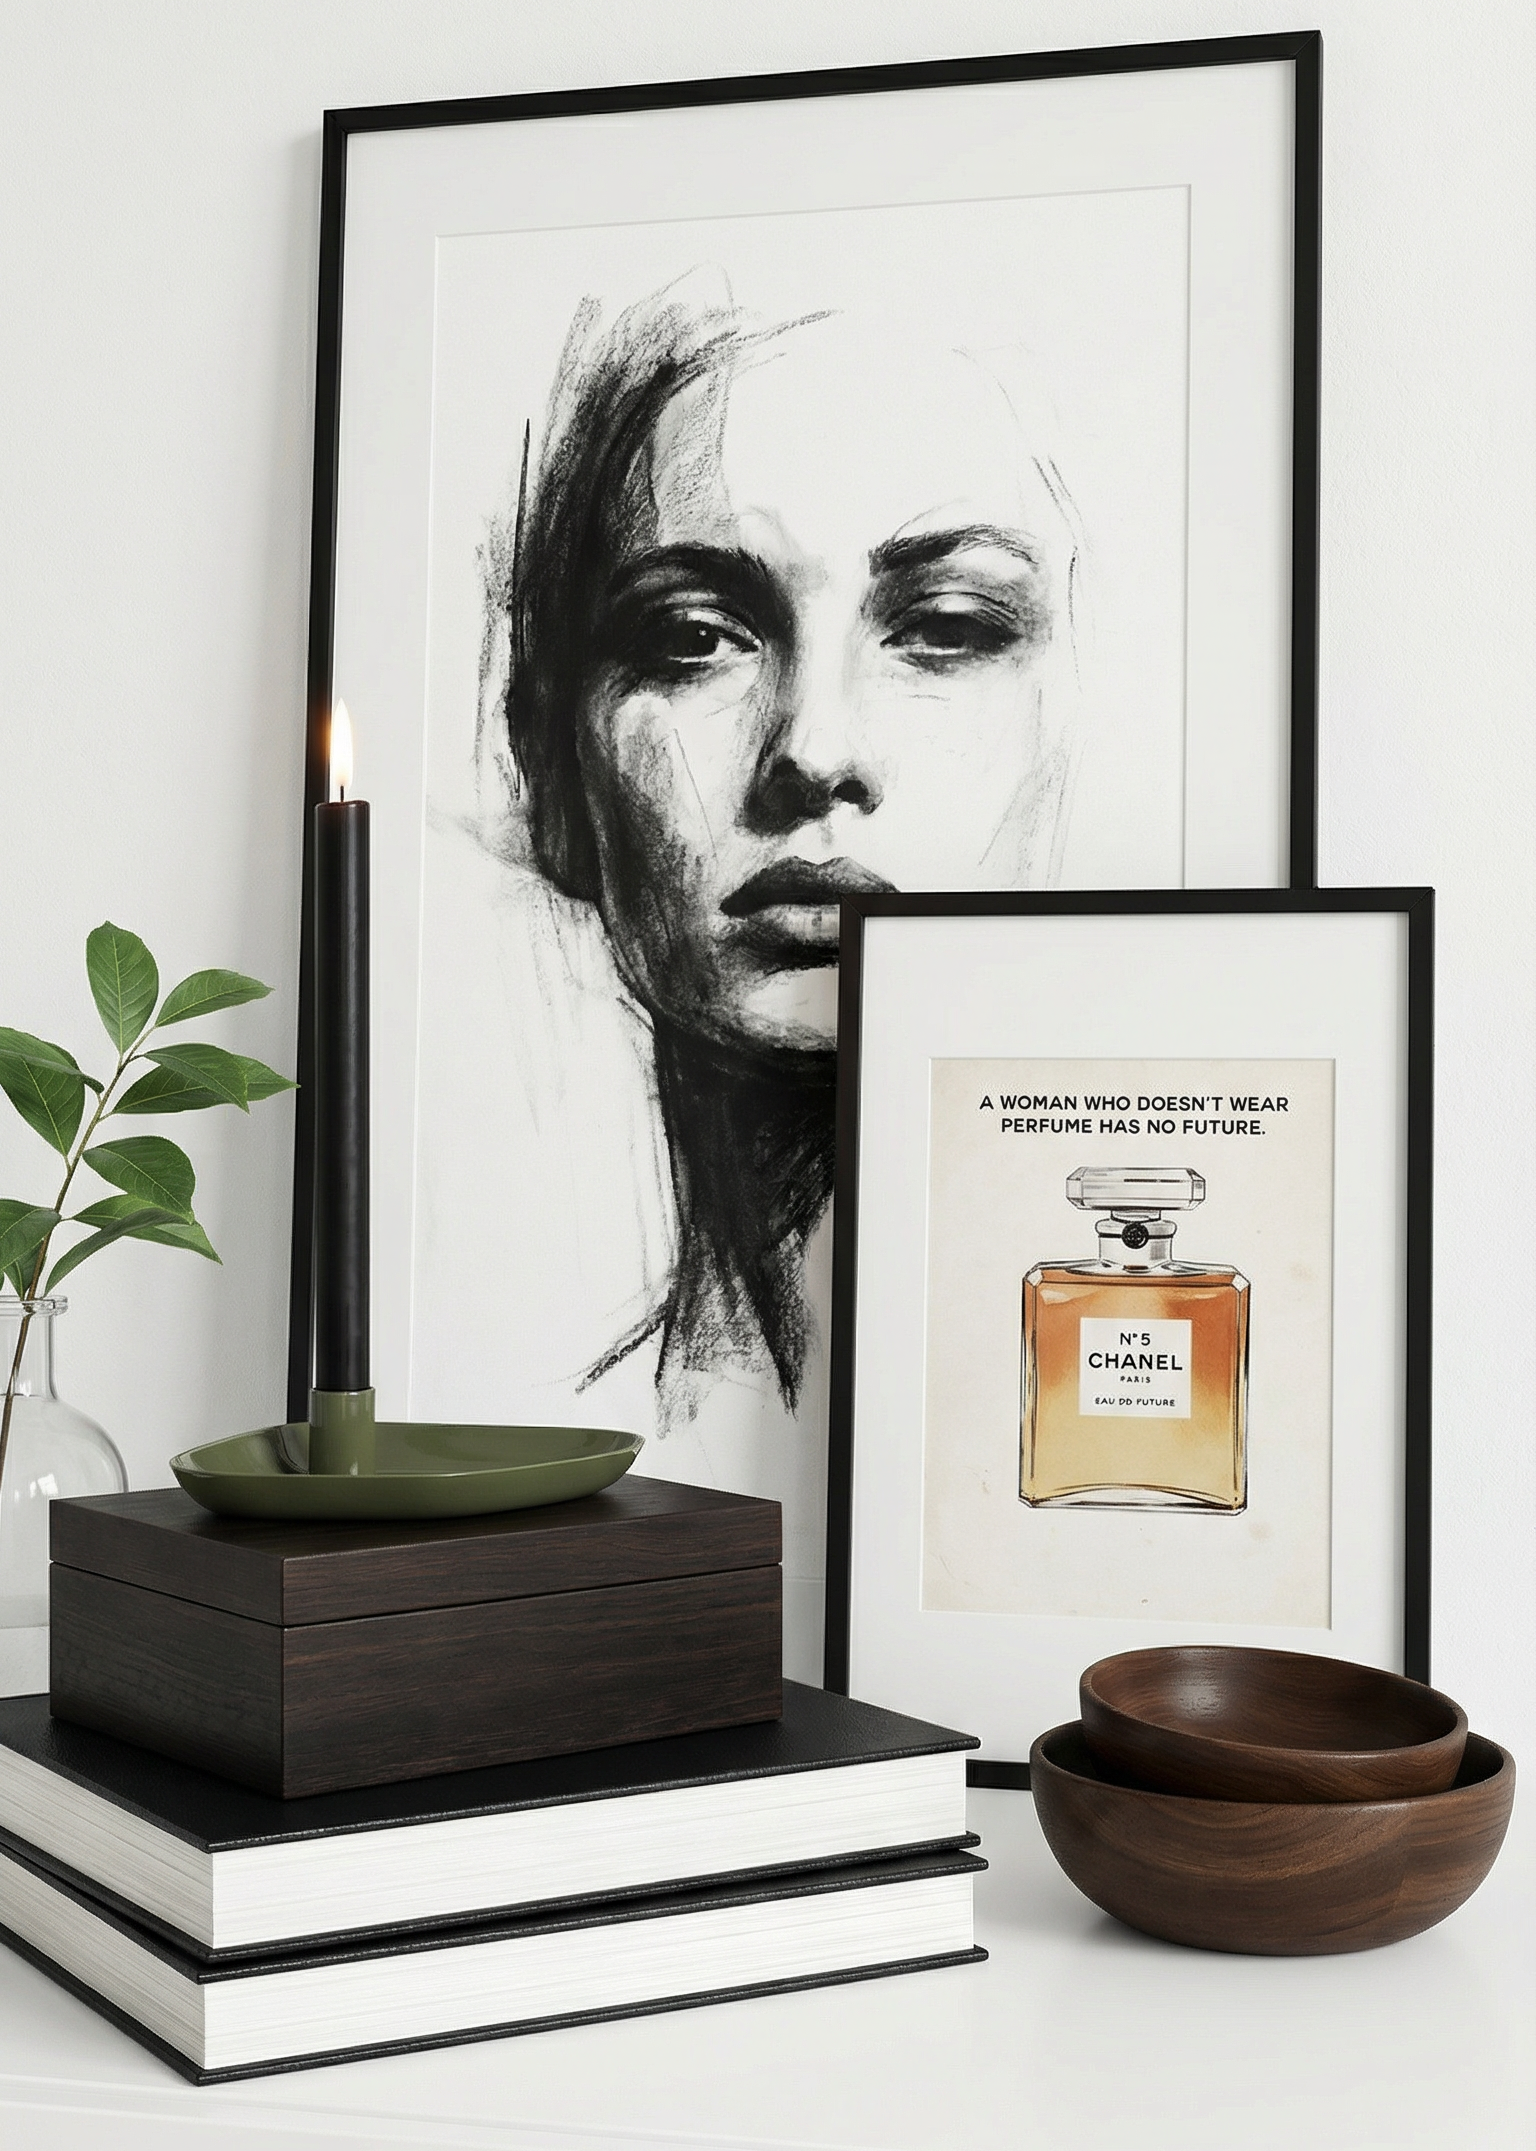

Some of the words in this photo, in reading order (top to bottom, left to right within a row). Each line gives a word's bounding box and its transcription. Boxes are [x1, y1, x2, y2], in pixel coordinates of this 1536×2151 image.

[980, 1096, 995, 1110] A
[1000, 1095, 1077, 1111] WOMAN
[1084, 1096, 1131, 1111] WHO
[1138, 1097, 1224, 1112] DOESN'T
[1230, 1097, 1289, 1112] WEAR
[1001, 1118, 1093, 1133] PERFUME
[1099, 1119, 1141, 1134] HAS
[1147, 1119, 1176, 1135] NO
[1183, 1120, 1266, 1135] FUTURE.
[1088, 1353, 1183, 1370] CHANEL
[1120, 1376, 1151, 1384] PARIS
[1095, 1397, 1115, 1405] EAU
